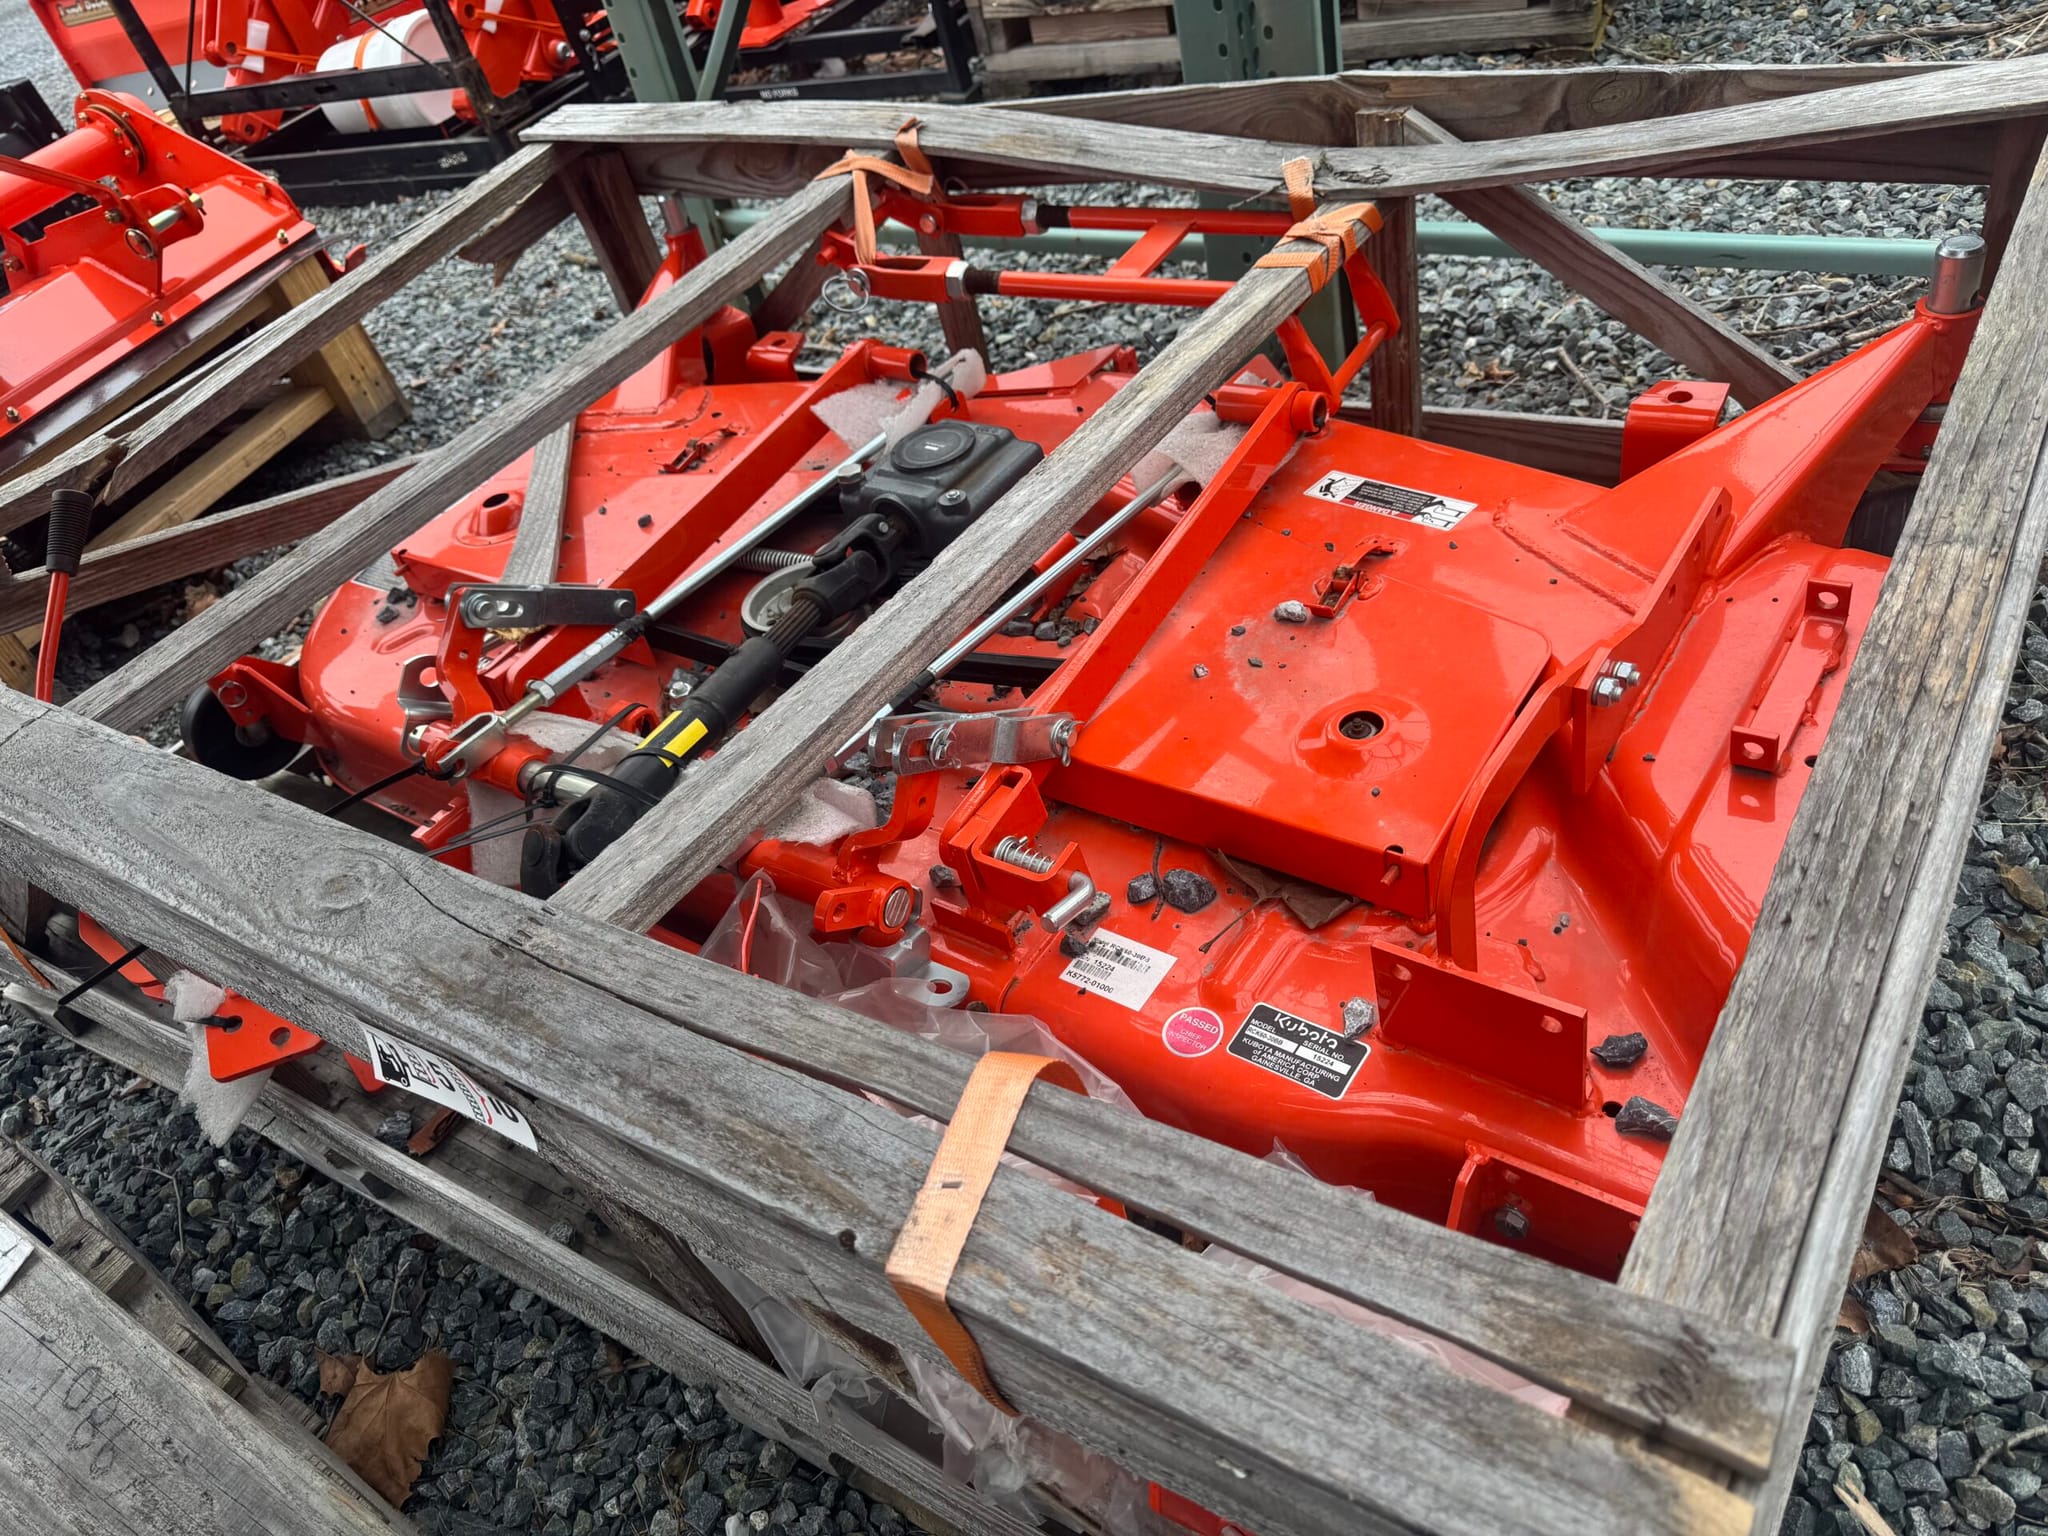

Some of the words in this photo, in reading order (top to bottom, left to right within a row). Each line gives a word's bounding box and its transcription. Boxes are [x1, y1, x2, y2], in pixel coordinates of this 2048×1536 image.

[1094, 959, 1116, 973] 15224
[1066, 969, 1114, 994] K5772-01000
[1179, 1012, 1218, 1034] PASSED
[1251, 1019, 1276, 1033] MODEL
[1274, 1013, 1338, 1049] Kubota
[1242, 1037, 1273, 1055] KUBOTA
[1275, 1050, 1340, 1082] MANUFACTURING
[1303, 1040, 1329, 1056] SERIAL
[1331, 1052, 1345, 1061] NO.
[1313, 1054, 1335, 1067] 15224
[1260, 1052, 1296, 1073] AMERICA
[1303, 1077, 1315, 1086] GA
